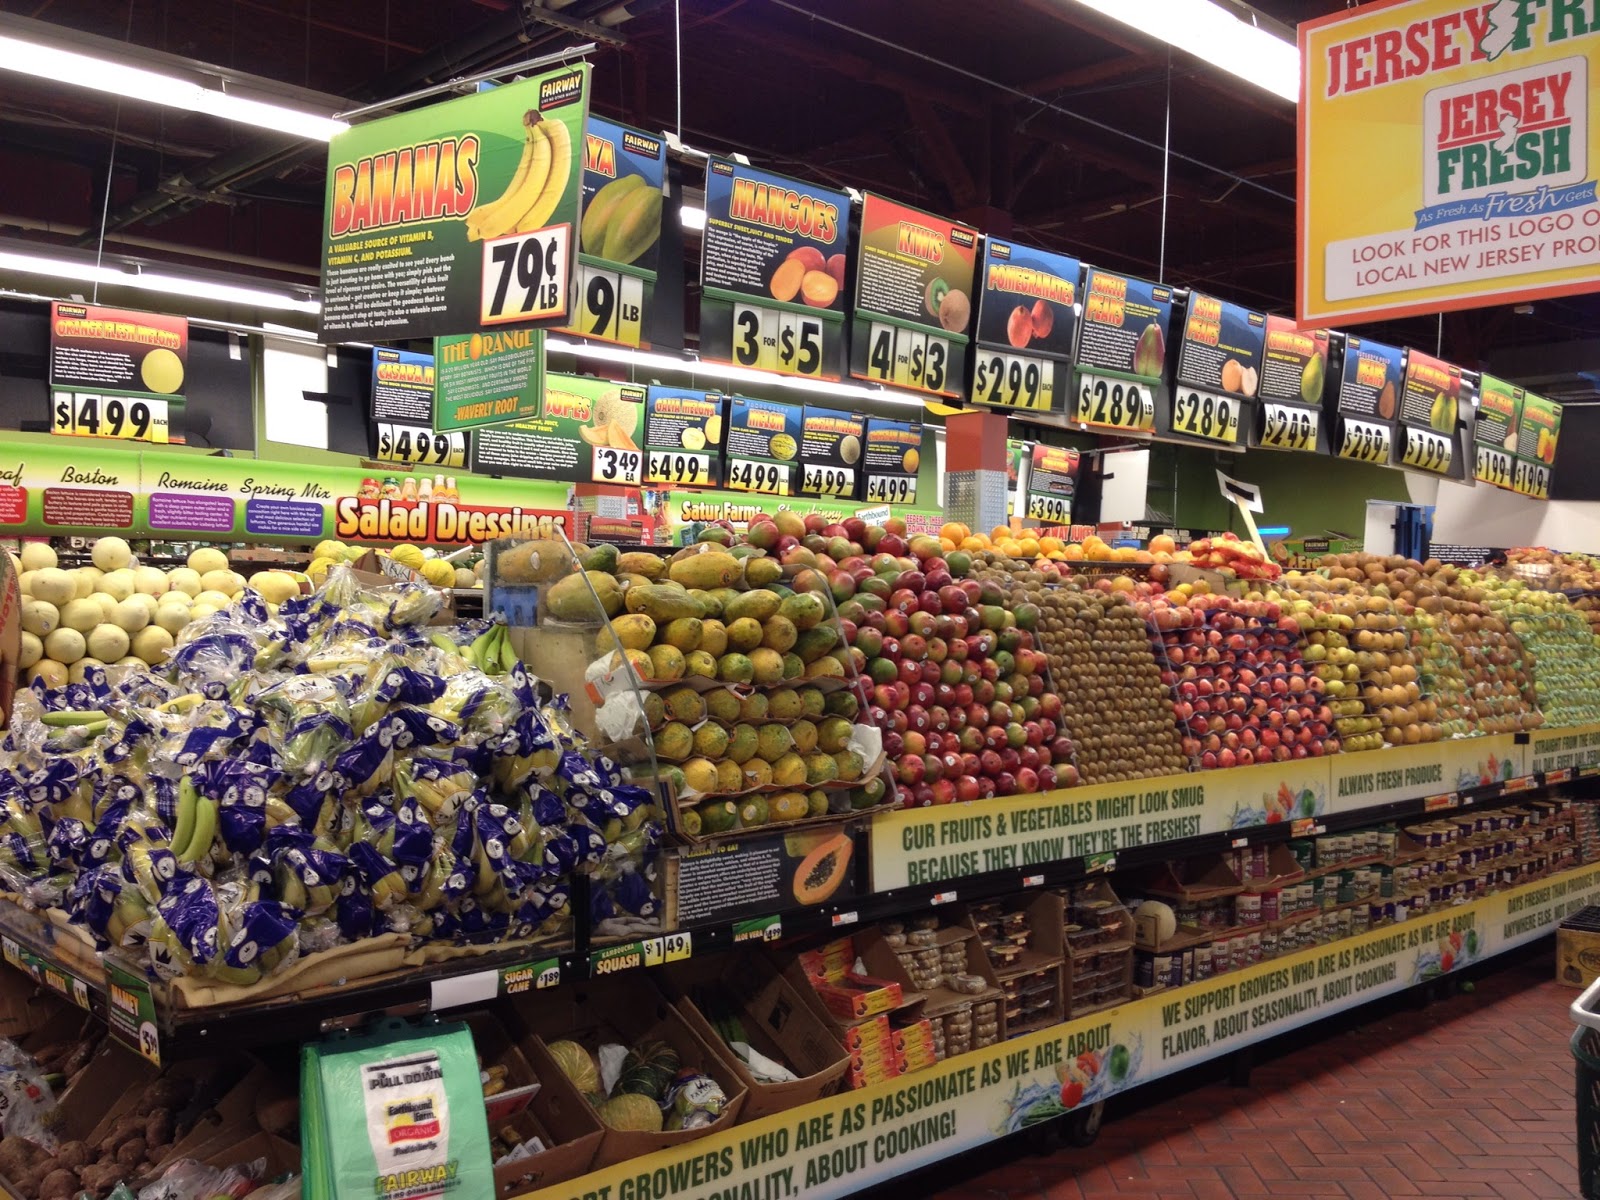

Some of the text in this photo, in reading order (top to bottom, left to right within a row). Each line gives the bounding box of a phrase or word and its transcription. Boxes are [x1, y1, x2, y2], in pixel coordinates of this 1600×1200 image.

[1328, 3, 1497, 98] JERSEY
[542, 75, 582, 98] FAIRWAY
[1438, 71, 1572, 144] JERSEY
[624, 134, 659, 152] FAIRWAY
[1437, 125, 1571, 195] FRESH
[330, 133, 479, 238] BANANAS
[731, 178, 837, 245] MANGOES
[1419, 185, 1594, 223] As Fresh As Fresh Gets
[328, 246, 333, 254] A
[334, 241, 364, 253] VALUABLE
[364, 238, 388, 250] SOURCE
[389, 236, 398, 246] OF
[399, 232, 426, 244] VITAMIN
[708, 218, 734, 230] SUPERBLY
[763, 230, 775, 240] AND
[775, 232, 794, 245] TENDER
[899, 222, 943, 264] KIWIS
[1352, 209, 1600, 264] LOOK FOR THIS LOGO O
[326, 268, 339, 276] These
[368, 263, 382, 273] really
[382, 261, 399, 270] excited
[405, 259, 414, 267] see
[425, 256, 439, 265] Every
[440, 253, 455, 262] bunch
[328, 255, 353, 266] VITAMIN
[361, 251, 375, 261] AND
[376, 246, 414, 260] POTASSIUM.
[1356, 235, 1600, 286] LOCAL NEW JERSEY PRO
[540, 284, 558, 309] LB
[988, 265, 1076, 308] POMEGRANATES
[58, 305, 86, 316] FAIRWAY
[622, 300, 639, 322] LB
[56, 318, 182, 349] ORANGE FLESH MELONS
[736, 310, 821, 374] 3 FOR $5
[442, 341, 470, 364] THE
[870, 330, 945, 391] 4 FOR $3
[377, 362, 423, 383] CASABA
[1042, 381, 1053, 392] EACH
[494, 396, 519, 415] ROOT
[1144, 404, 1153, 415] LB
[153, 418, 168, 427] EACH
[1229, 418, 1237, 429] LB
[0, 463, 24, 487] eaf
[60, 466, 119, 486] Boston
[157, 471, 229, 492] Romaine
[625, 471, 635, 482] EA
[240, 478, 332, 502] Spring Mix
[336, 496, 429, 541] Salad
[434, 502, 566, 545] Dressings
[681, 500, 721, 523] Satur
[1338, 763, 1443, 800] ALWAYS FRESH PRODUCE
[902, 784, 1205, 852] OUR FRUITS & VEGETABLES MIGHT LOOK SMUG
[907, 813, 1202, 888] BECAUSE THEY KNOW THEY'RE THE FRESHEST
[735, 929, 764, 944] ALOE VERA
[601, 943, 635, 959] KAMBOUCHA
[596, 954, 641, 975] SQUASH
[1162, 1003, 1182, 1028] WE
[1184, 984, 1236, 1019] SUPPORT
[1238, 969, 1289, 1000] GROWERS
[1291, 962, 1316, 987] WHO
[1317, 957, 1337, 981] ARE
[1337, 953, 1351, 973] AS
[1352, 935, 1406, 970] PASSIONATE
[1407, 930, 1420, 949] AS
[1420, 925, 1436, 946] WE
[1436, 920, 1451, 939] ARE
[1452, 910, 1476, 934] ABOUT
[504, 969, 533, 986] SUGAR
[507, 981, 530, 996] CANE
[1162, 965, 1398, 1060] FLAVOR, ABOUT SEASONALITY, ABOUT COOKING!
[369, 1068, 444, 1091] PULL DOWN
[388, 1098, 433, 1116] Earthbound
[618, 1146, 734, 1200] GROWERS
[739, 1127, 789, 1169] WHO
[795, 1111, 834, 1151] ARE
[838, 1104, 867, 1137] AS
[870, 1064, 976, 1128] PASSIONATE
[979, 1058, 1003, 1090] AS
[1006, 1051, 1033, 1079] WE
[1033, 1042, 1063, 1072] ARE
[1066, 1022, 1113, 1061] ABOUT
[393, 1126, 438, 1140] ORGANIC
[695, 1109, 958, 1200] ONALITY, ABOUT COOKING!
[374, 1160, 459, 1195] FAIRWAY
